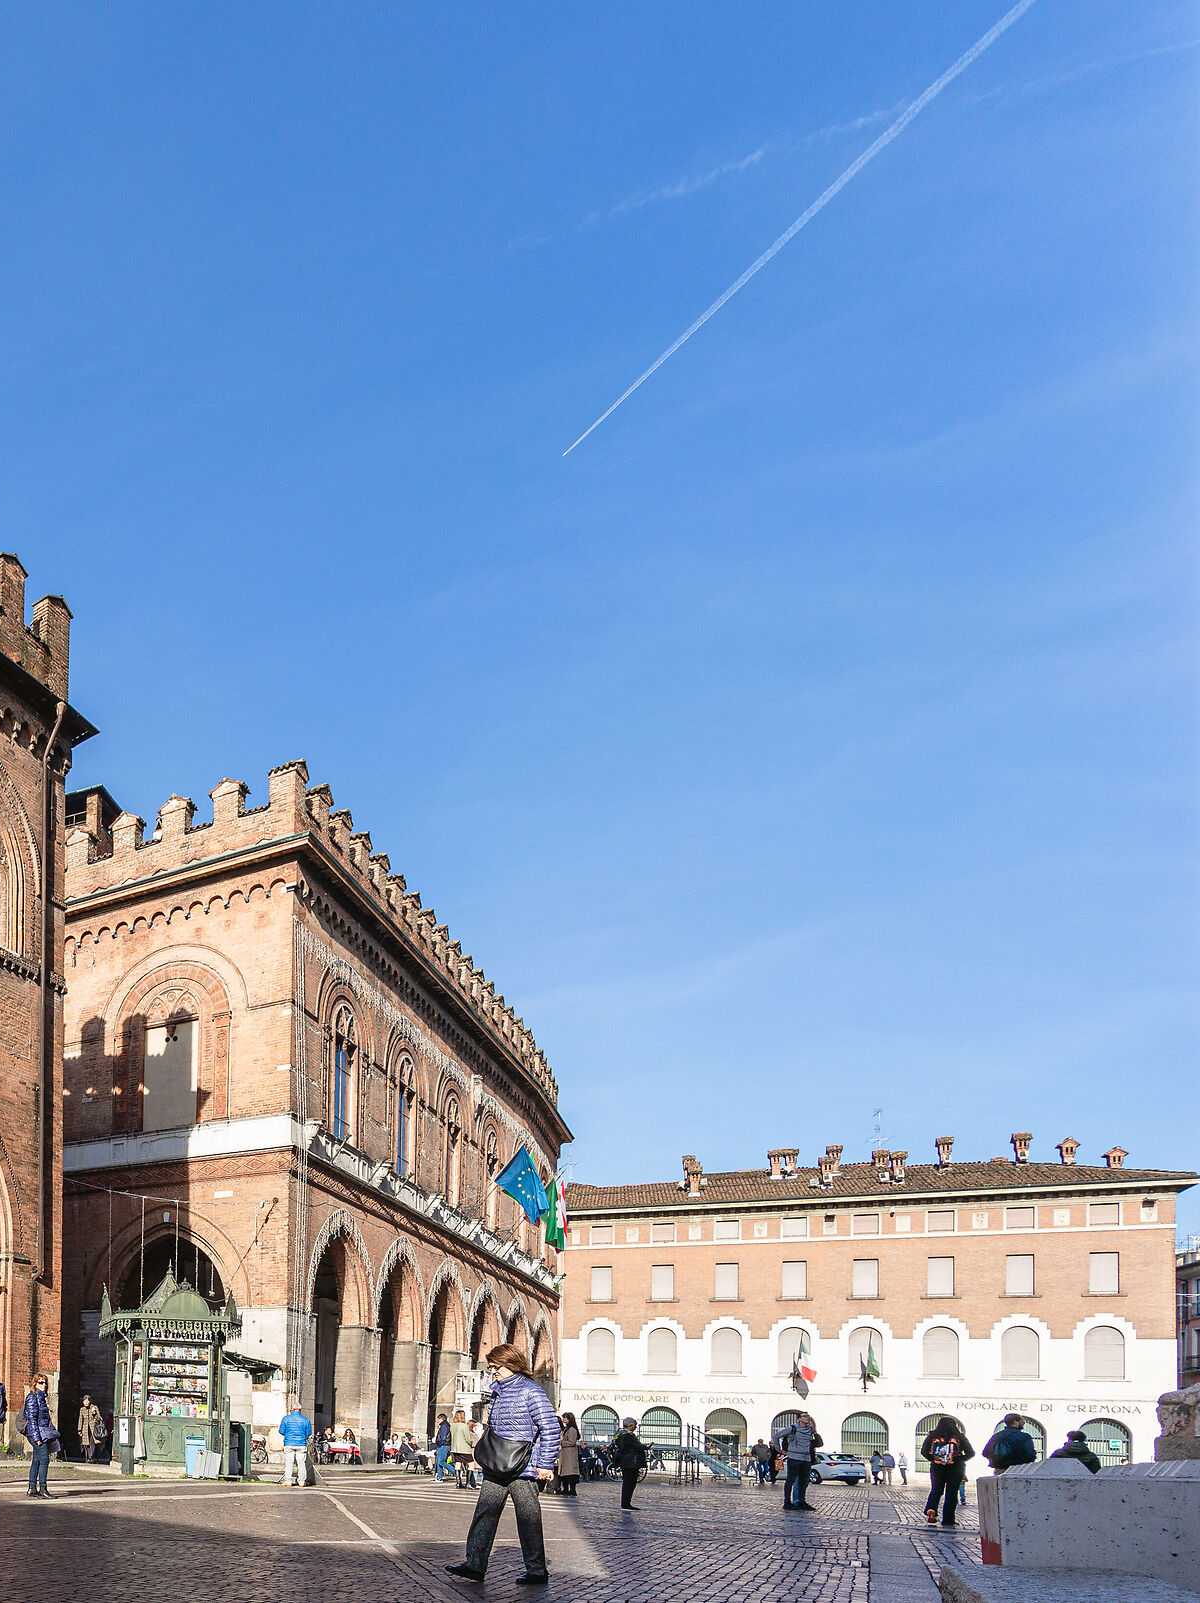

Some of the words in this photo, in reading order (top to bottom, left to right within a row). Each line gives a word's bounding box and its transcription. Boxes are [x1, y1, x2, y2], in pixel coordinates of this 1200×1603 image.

[614, 1394, 670, 1403] POPOLARE
[680, 1396, 691, 1404] DI
[699, 1396, 755, 1405] CREMONA
[903, 1400, 945, 1409] BANCA
[956, 1401, 1028, 1411] POPOLARE
[1040, 1403, 1053, 1412] DI
[1066, 1404, 1141, 1414] CREMONA
